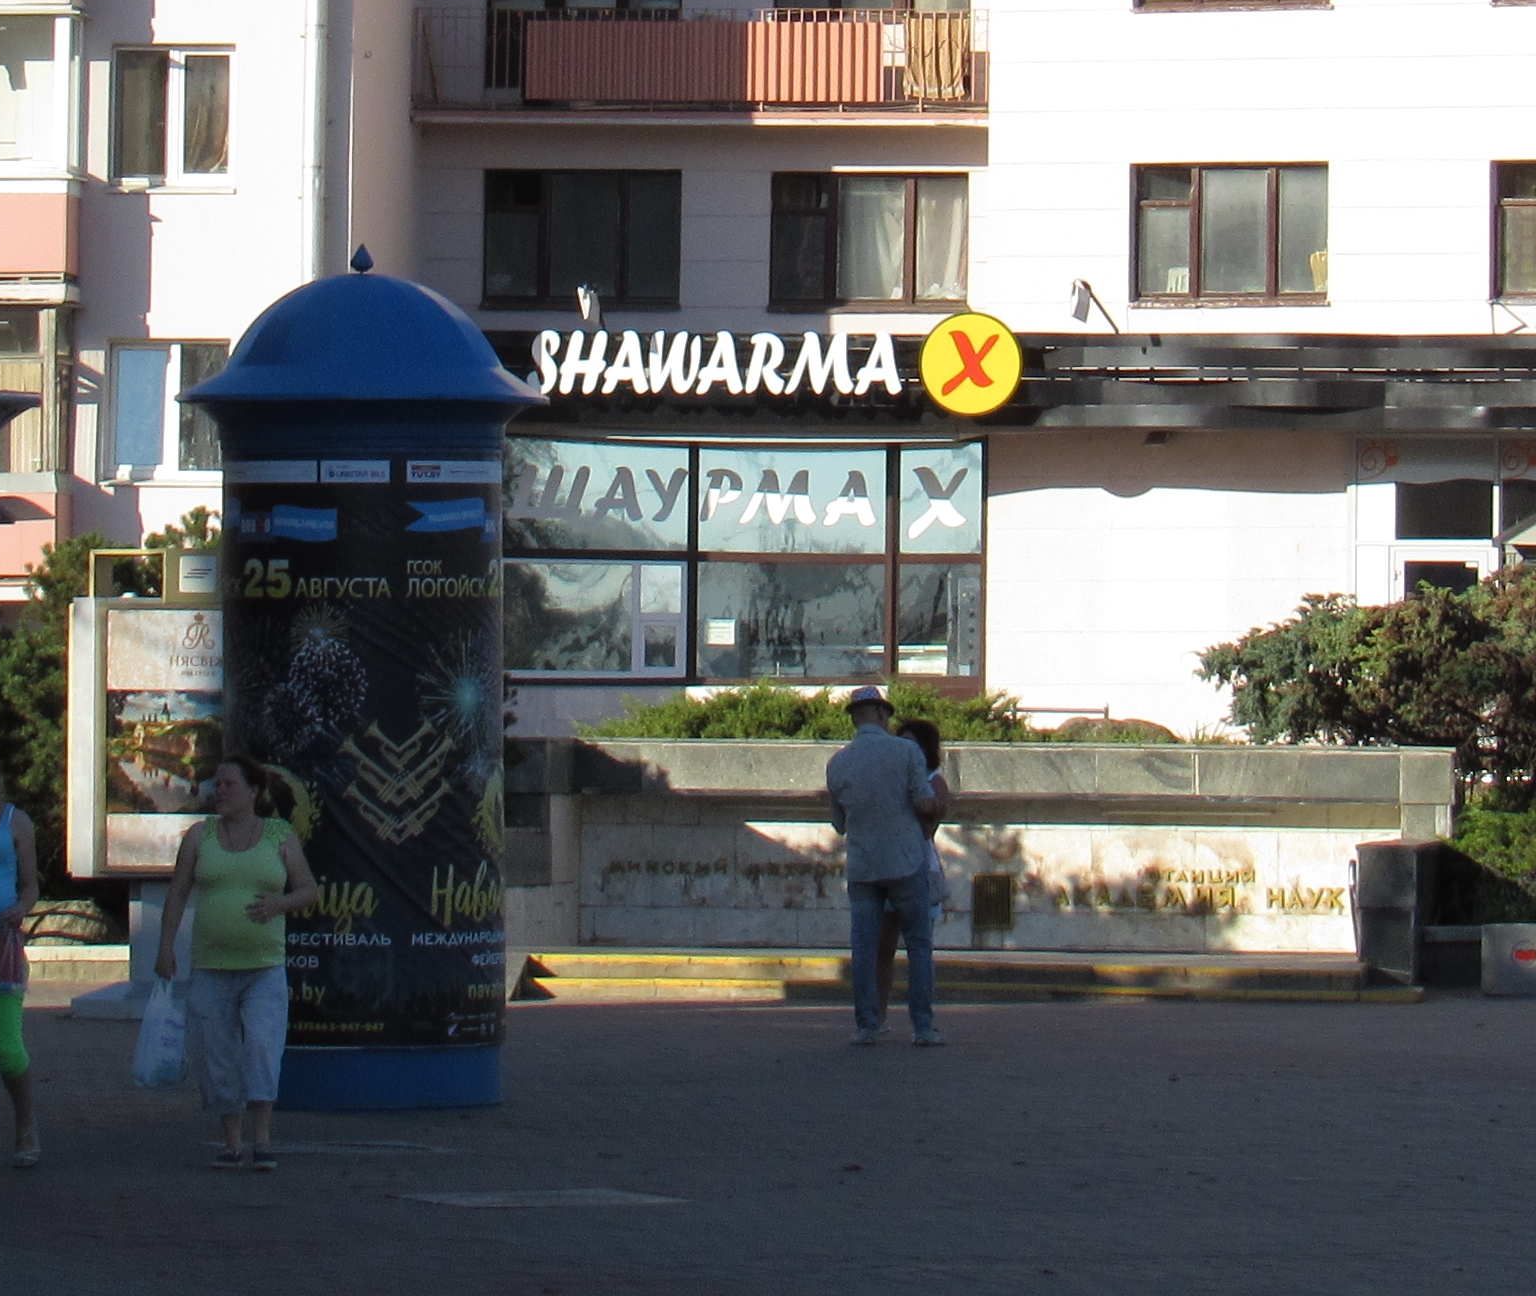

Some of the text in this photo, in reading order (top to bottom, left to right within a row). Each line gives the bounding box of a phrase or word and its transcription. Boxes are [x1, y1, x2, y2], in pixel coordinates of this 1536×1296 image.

[527, 329, 902, 397] SHAWARMA
[513, 464, 877, 527] ШАУРМА
[243, 558, 292, 599] 25
[406, 559, 442, 575] ГСОК
[295, 577, 392, 598] АВГУСТА
[405, 574, 487, 598] ЛОГОЙСК
[1265, 886, 1346, 910] НАУК
[287, 932, 393, 946] ФЕСТИВАЛЬ
[287, 954, 320, 969] КОВ
